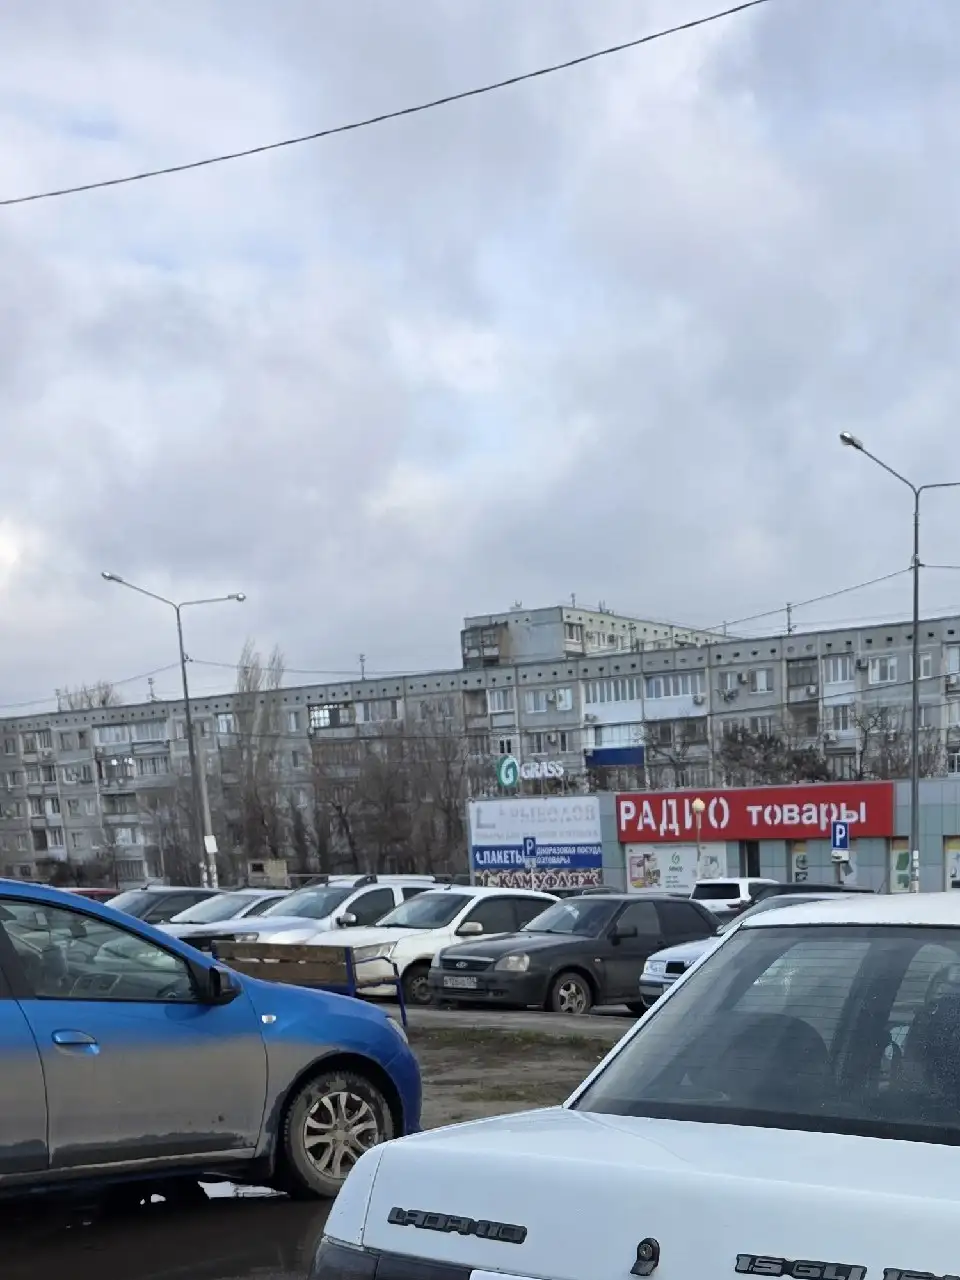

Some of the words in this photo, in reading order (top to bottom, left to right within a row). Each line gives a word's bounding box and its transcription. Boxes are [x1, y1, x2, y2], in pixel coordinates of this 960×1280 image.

[521, 761, 564, 779] GRASS
[620, 796, 730, 836] РАДИО
[746, 801, 867, 832] товары
[482, 849, 525, 864] ПАКЕТЫ
[388, 1207, 474, 1235] LADA
[476, 1220, 527, 1244] 110
